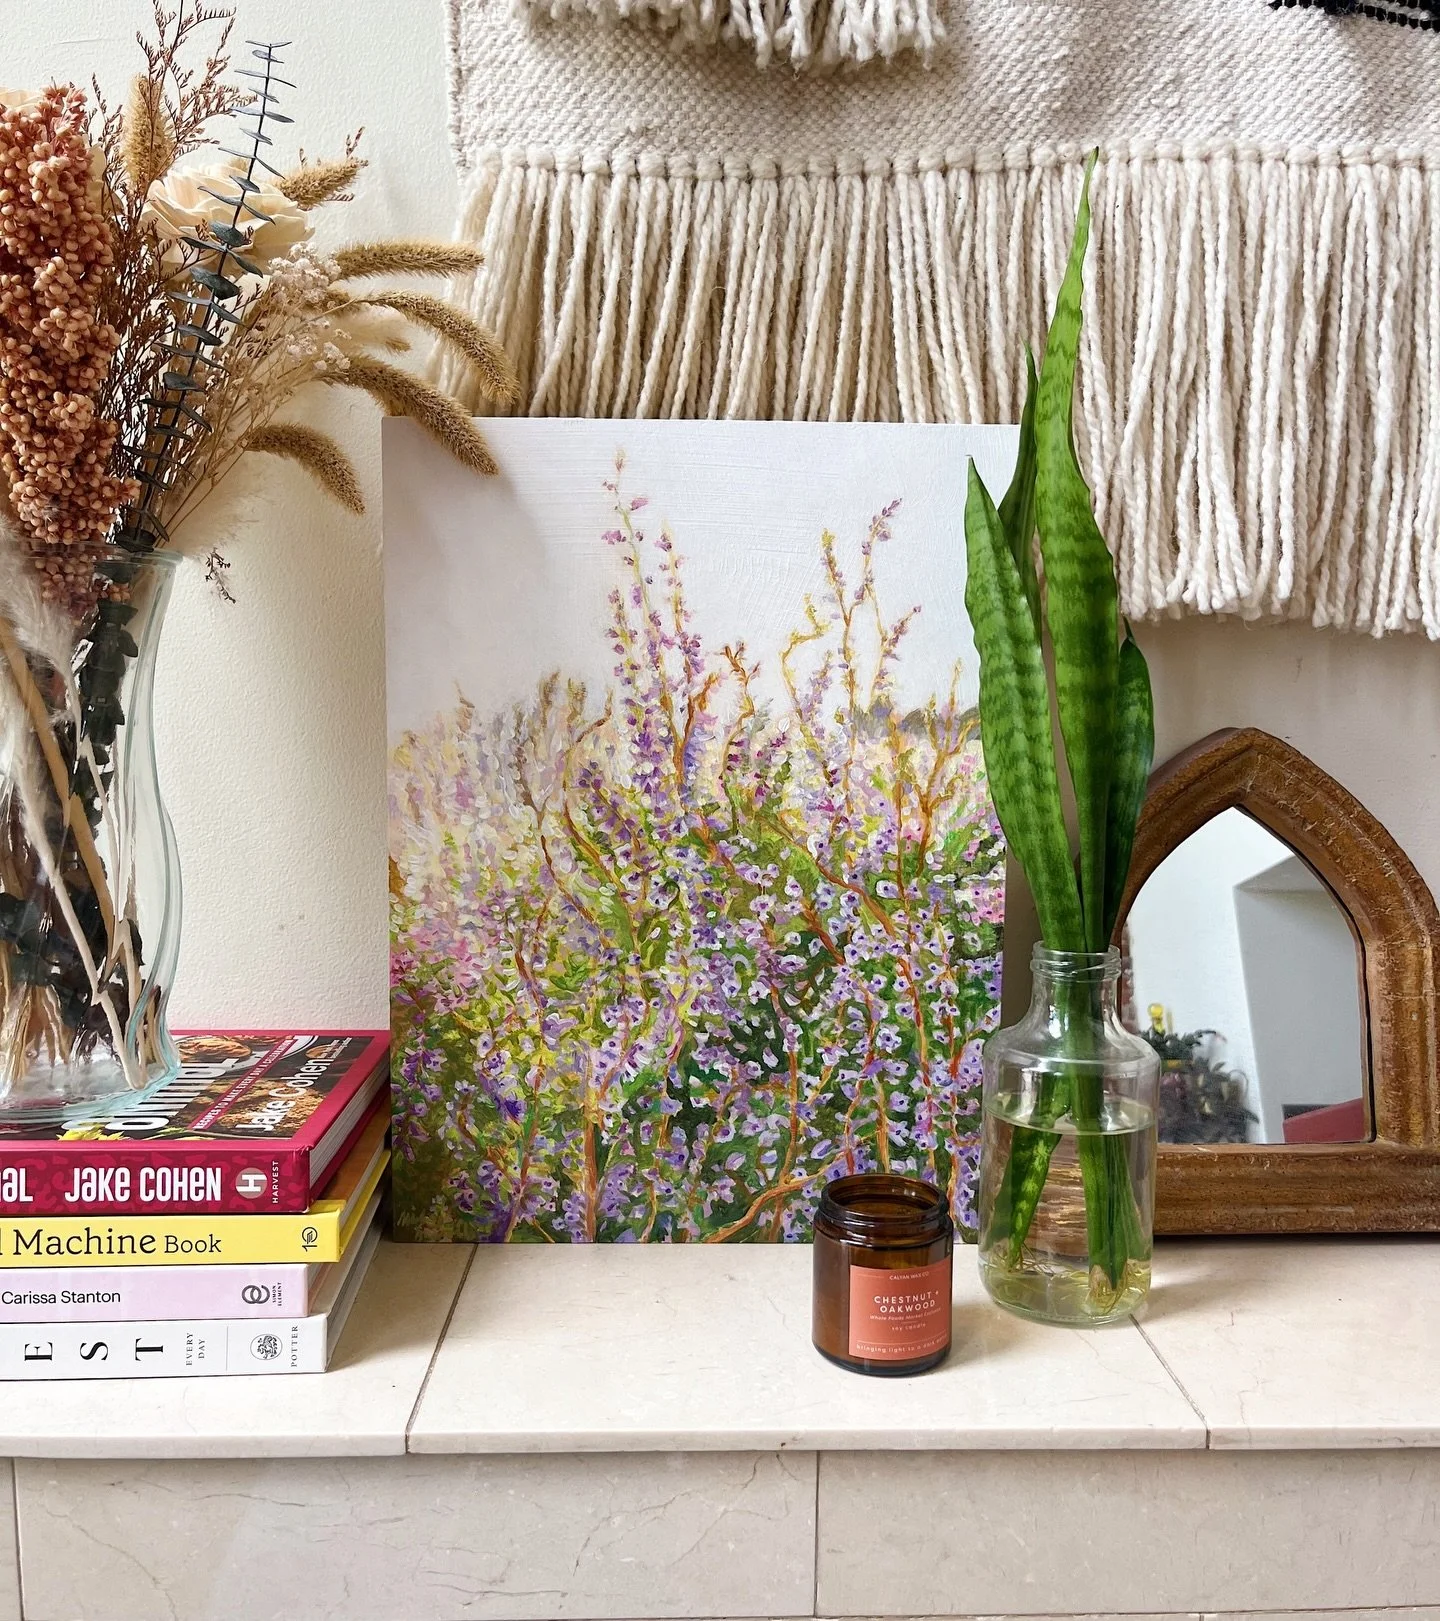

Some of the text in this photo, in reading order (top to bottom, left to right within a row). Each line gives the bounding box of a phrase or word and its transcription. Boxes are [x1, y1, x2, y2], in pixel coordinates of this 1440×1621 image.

[235, 1058, 334, 1132] Jake Cohen
[13, 1226, 156, 1256] Machine
[164, 1233, 222, 1254] Book
[1, 1290, 121, 1305] Carissa Stanton
[873, 1291, 932, 1304] CHESTNUT
[879, 1299, 936, 1313] OAKWOOD
[185, 1332, 194, 1366] EVERY
[197, 1338, 206, 1359] DAY
[290, 1325, 299, 1367] POTTER
